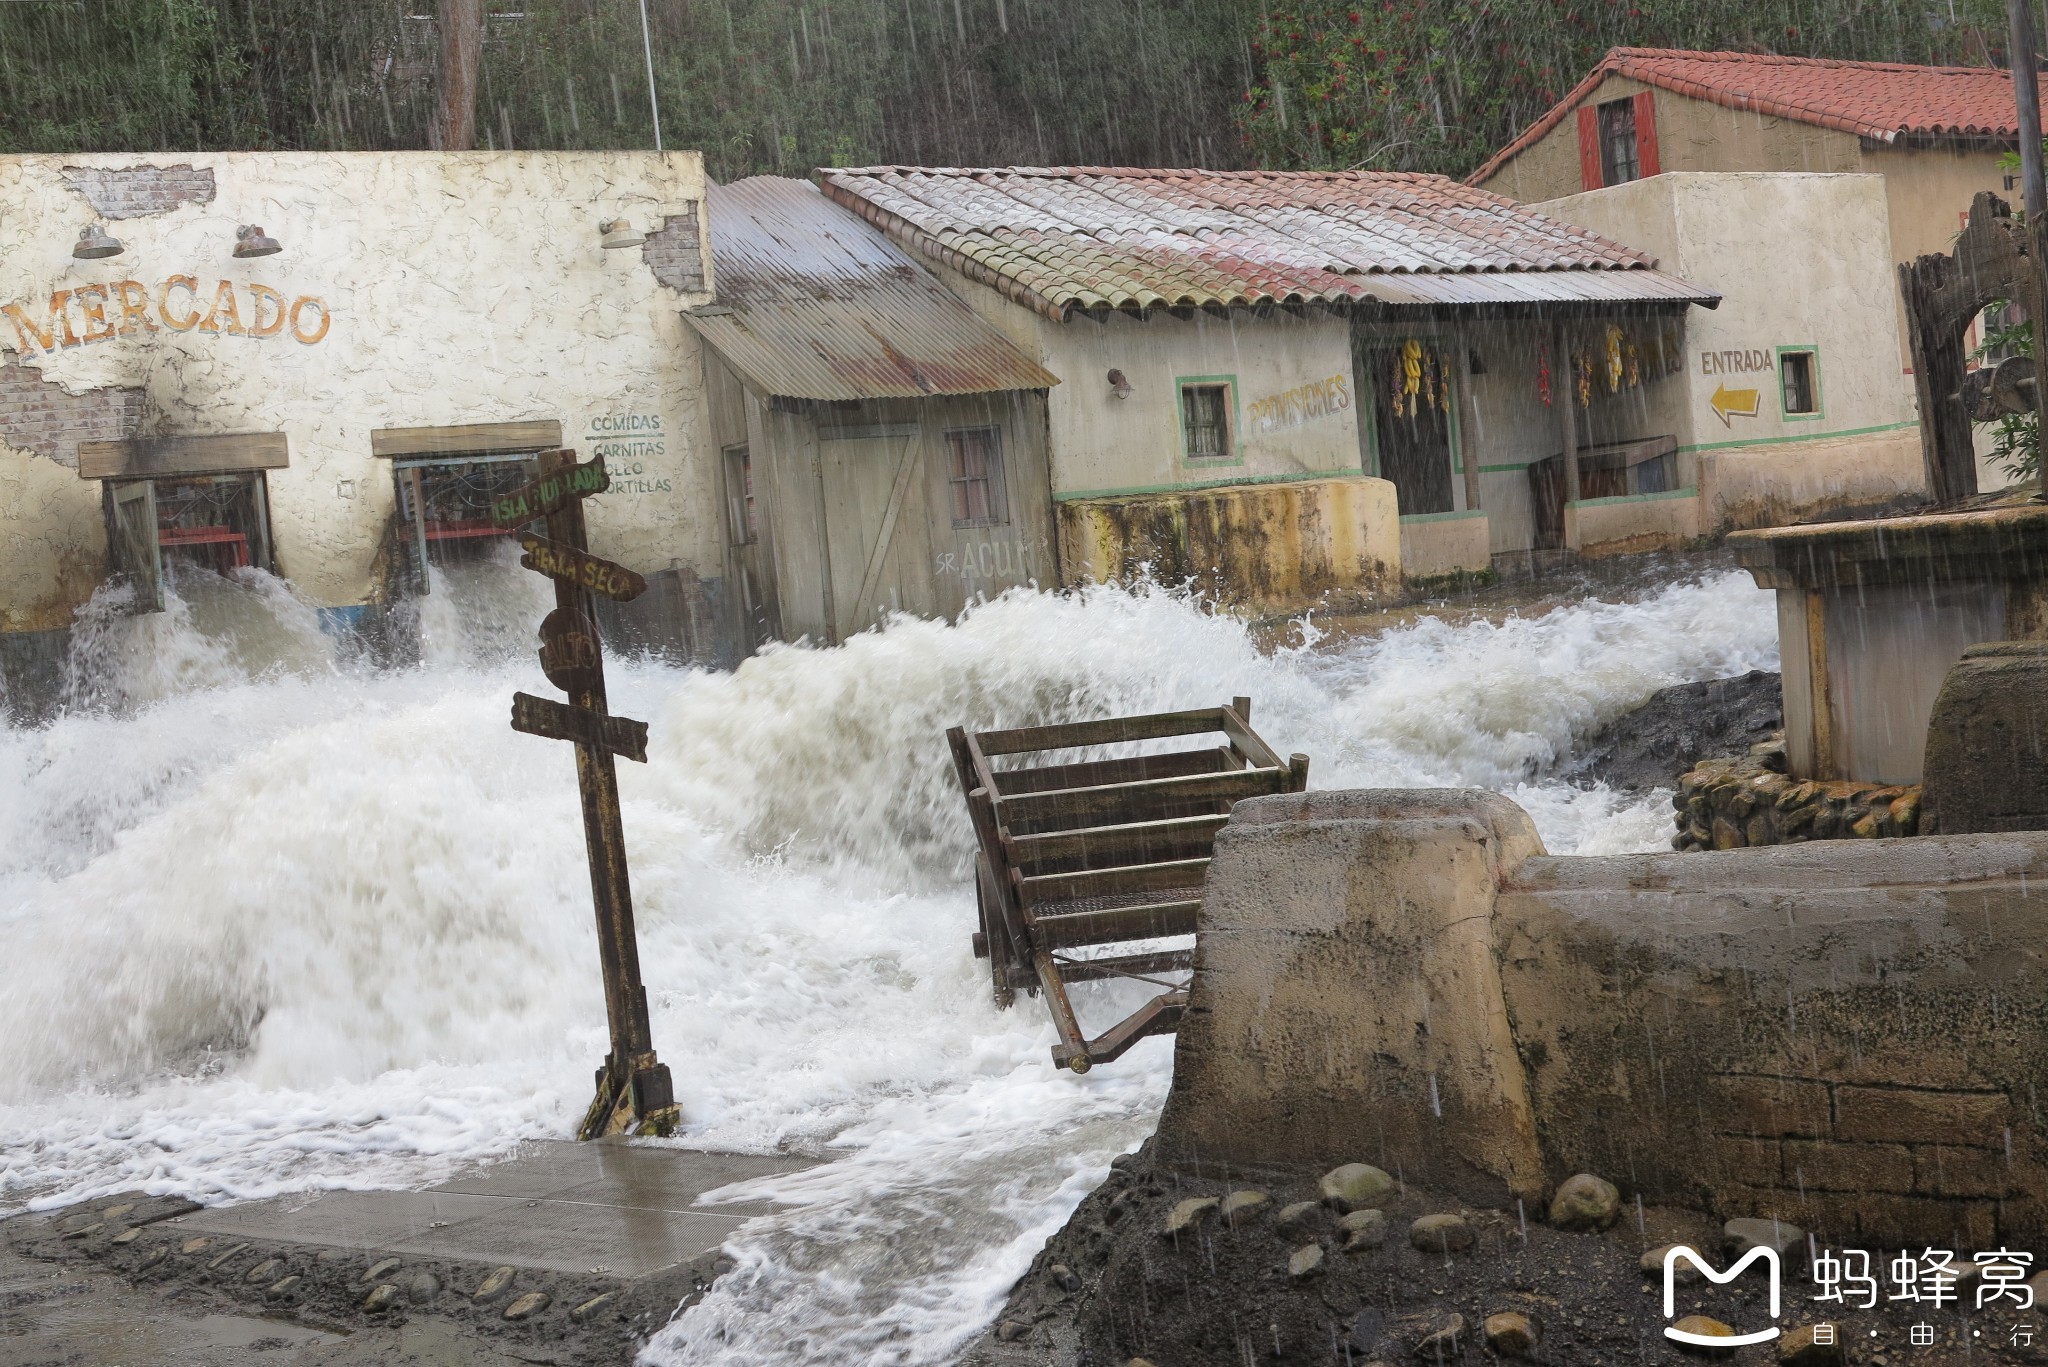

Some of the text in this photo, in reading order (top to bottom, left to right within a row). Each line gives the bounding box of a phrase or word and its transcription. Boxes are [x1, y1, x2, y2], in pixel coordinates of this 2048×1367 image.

[1, 274, 331, 360] MERCADO
[1701, 349, 1774, 375] ENTRADA
[591, 415, 660, 431] COMIDAS
[593, 441, 665, 457] CARNITAS
[603, 462, 643, 476] OLLO
[603, 479, 672, 494] ORTILLAS
[492, 494, 530, 521] ISLA
[583, 562, 632, 596] SECA
[544, 631, 597, 674] ALTO
